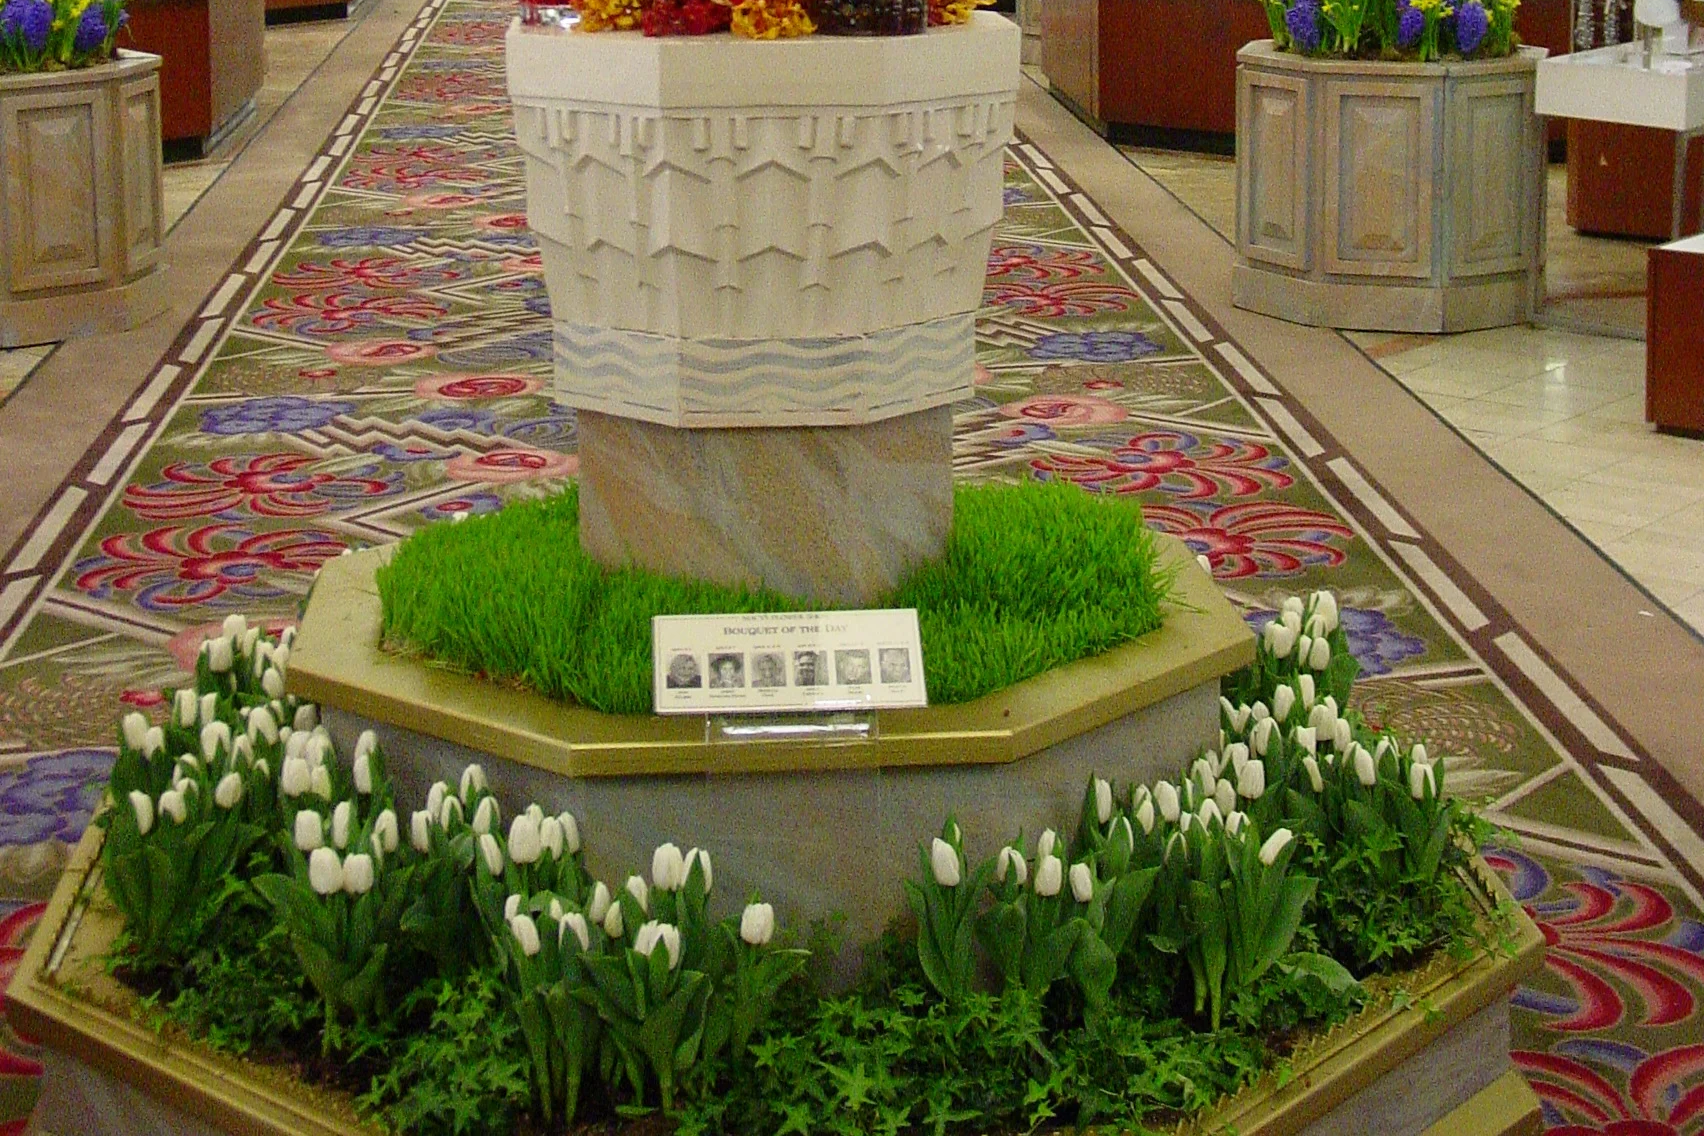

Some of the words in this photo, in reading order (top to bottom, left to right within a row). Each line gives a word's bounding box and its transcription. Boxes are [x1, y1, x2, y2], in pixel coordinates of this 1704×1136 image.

[723, 626, 779, 636] BOUQUET
[781, 626, 796, 634] OF
[800, 625, 820, 633] THE
